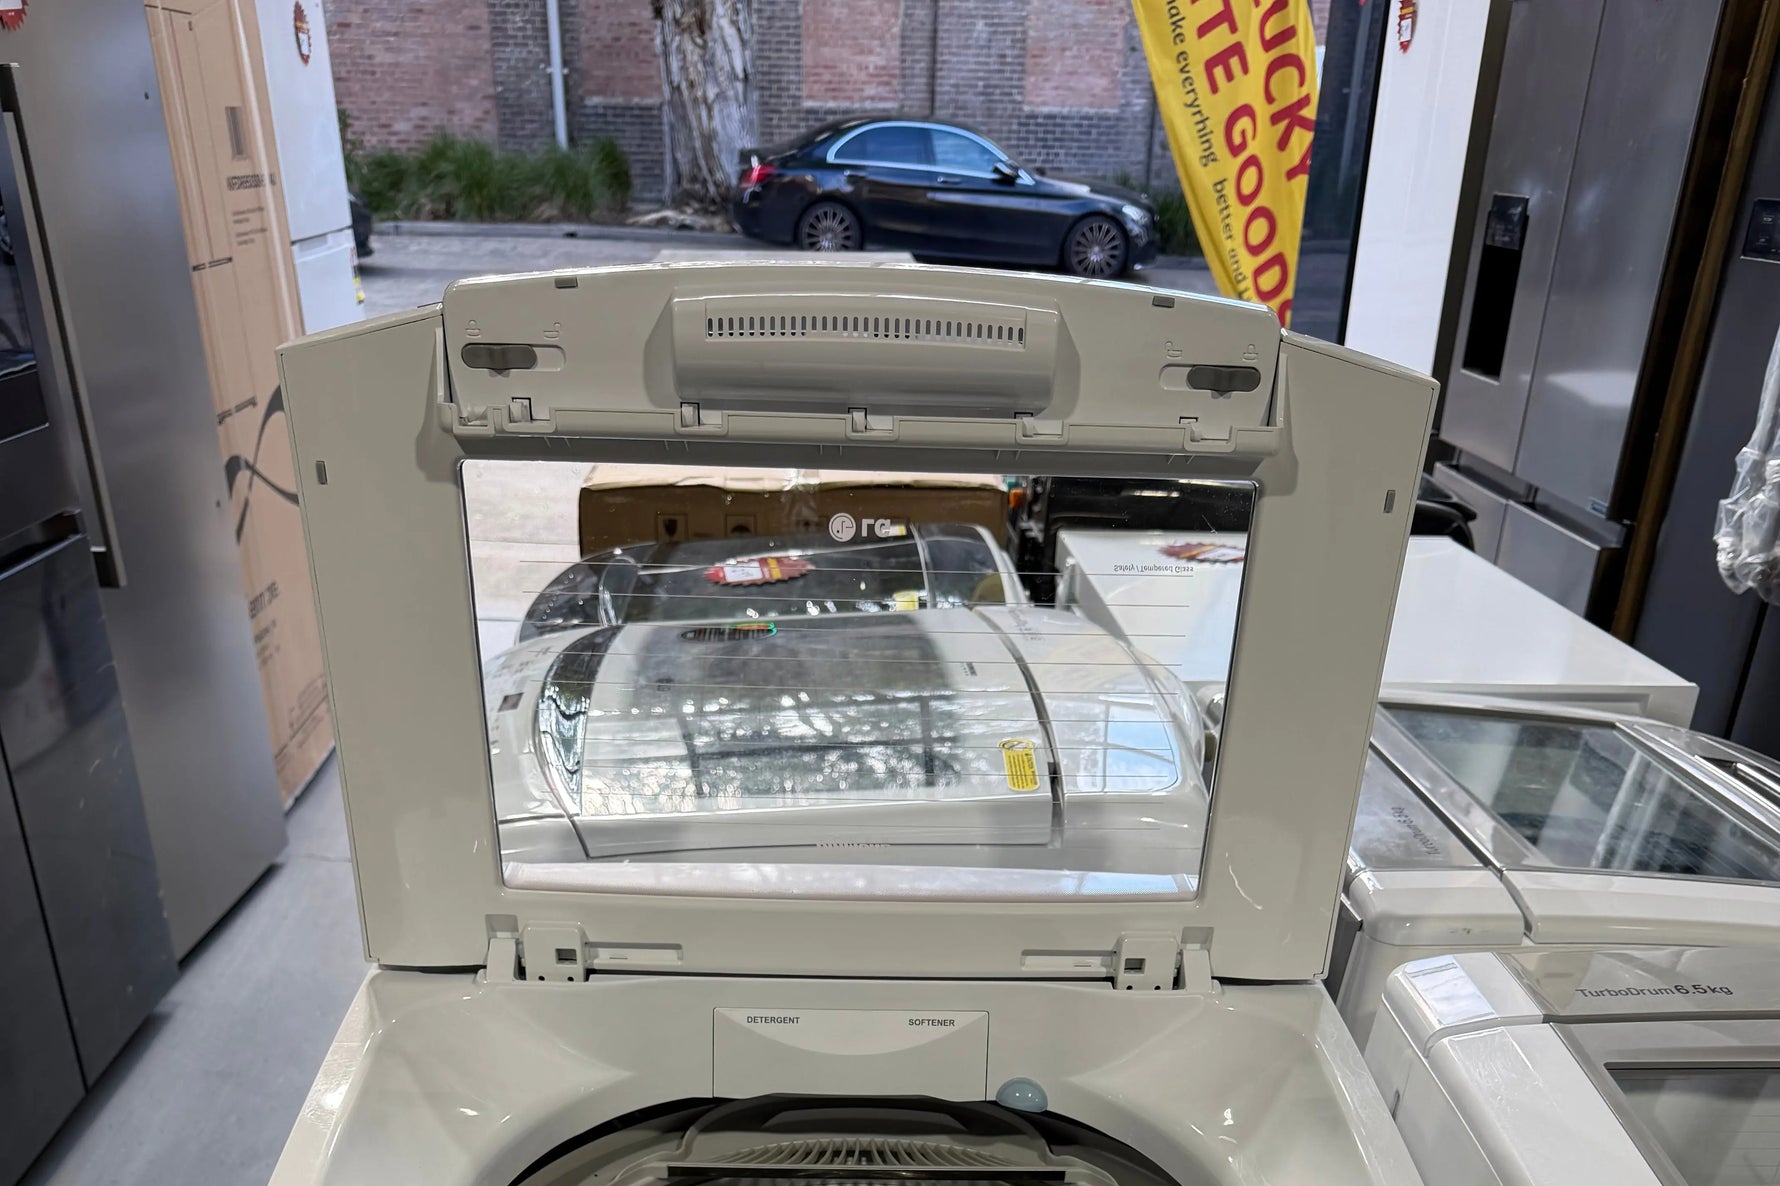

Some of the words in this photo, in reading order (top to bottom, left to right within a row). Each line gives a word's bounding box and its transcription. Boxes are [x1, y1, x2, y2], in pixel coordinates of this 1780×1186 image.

[1190, 0, 1248, 95] TE
[1255, 0, 1316, 181] UCKY
[1213, 178, 1233, 241] better
[1228, 248, 1249, 287] and
[746, 1015, 800, 1024] DETERGENT
[908, 1018, 955, 1027] SOFTENER
